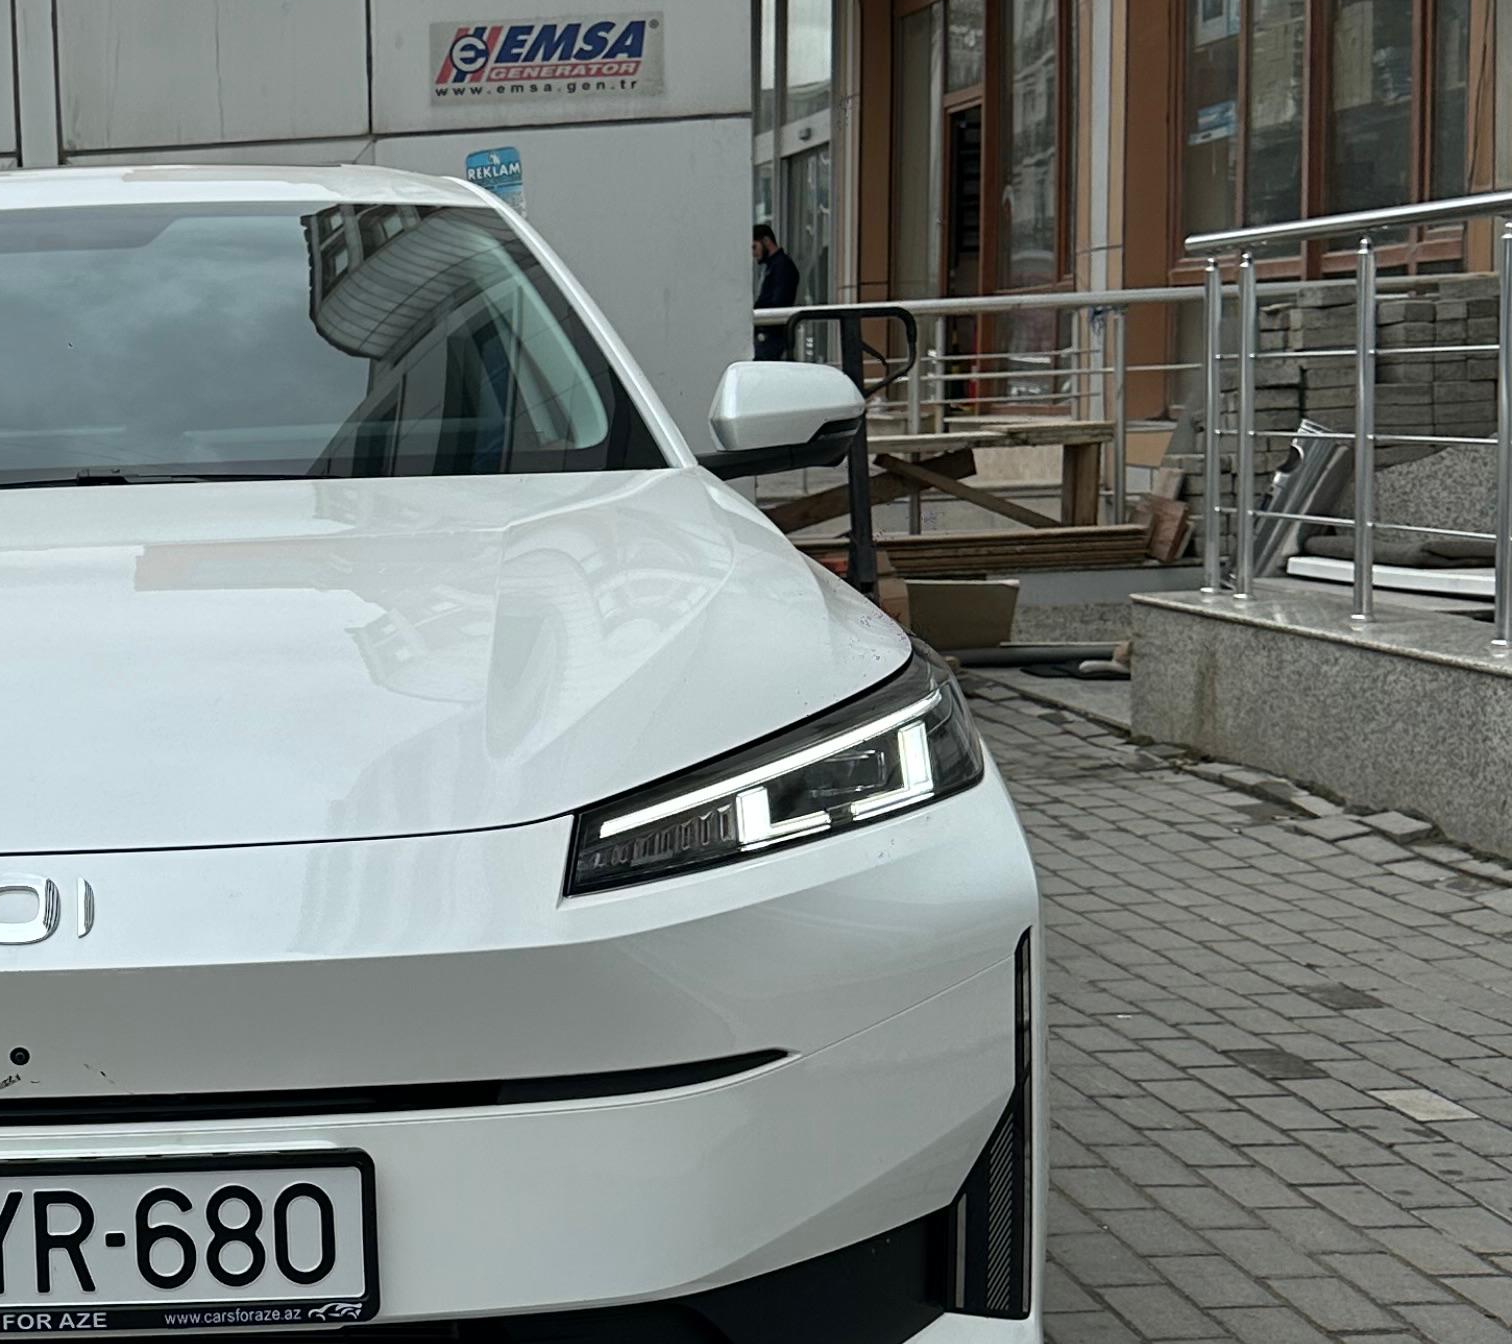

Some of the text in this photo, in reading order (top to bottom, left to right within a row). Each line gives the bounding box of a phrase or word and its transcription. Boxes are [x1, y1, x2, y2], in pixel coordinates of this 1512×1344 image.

[494, 20, 646, 64] EMSA
[490, 63, 636, 80] GENERATOR
[435, 79, 637, 97] www.emsa.gen.tr
[467, 162, 521, 181] REKLAM
[2, 1313, 53, 1331] FOR
[58, 1312, 108, 1329] AZE
[165, 1308, 302, 1325] www.carsforaze.az
